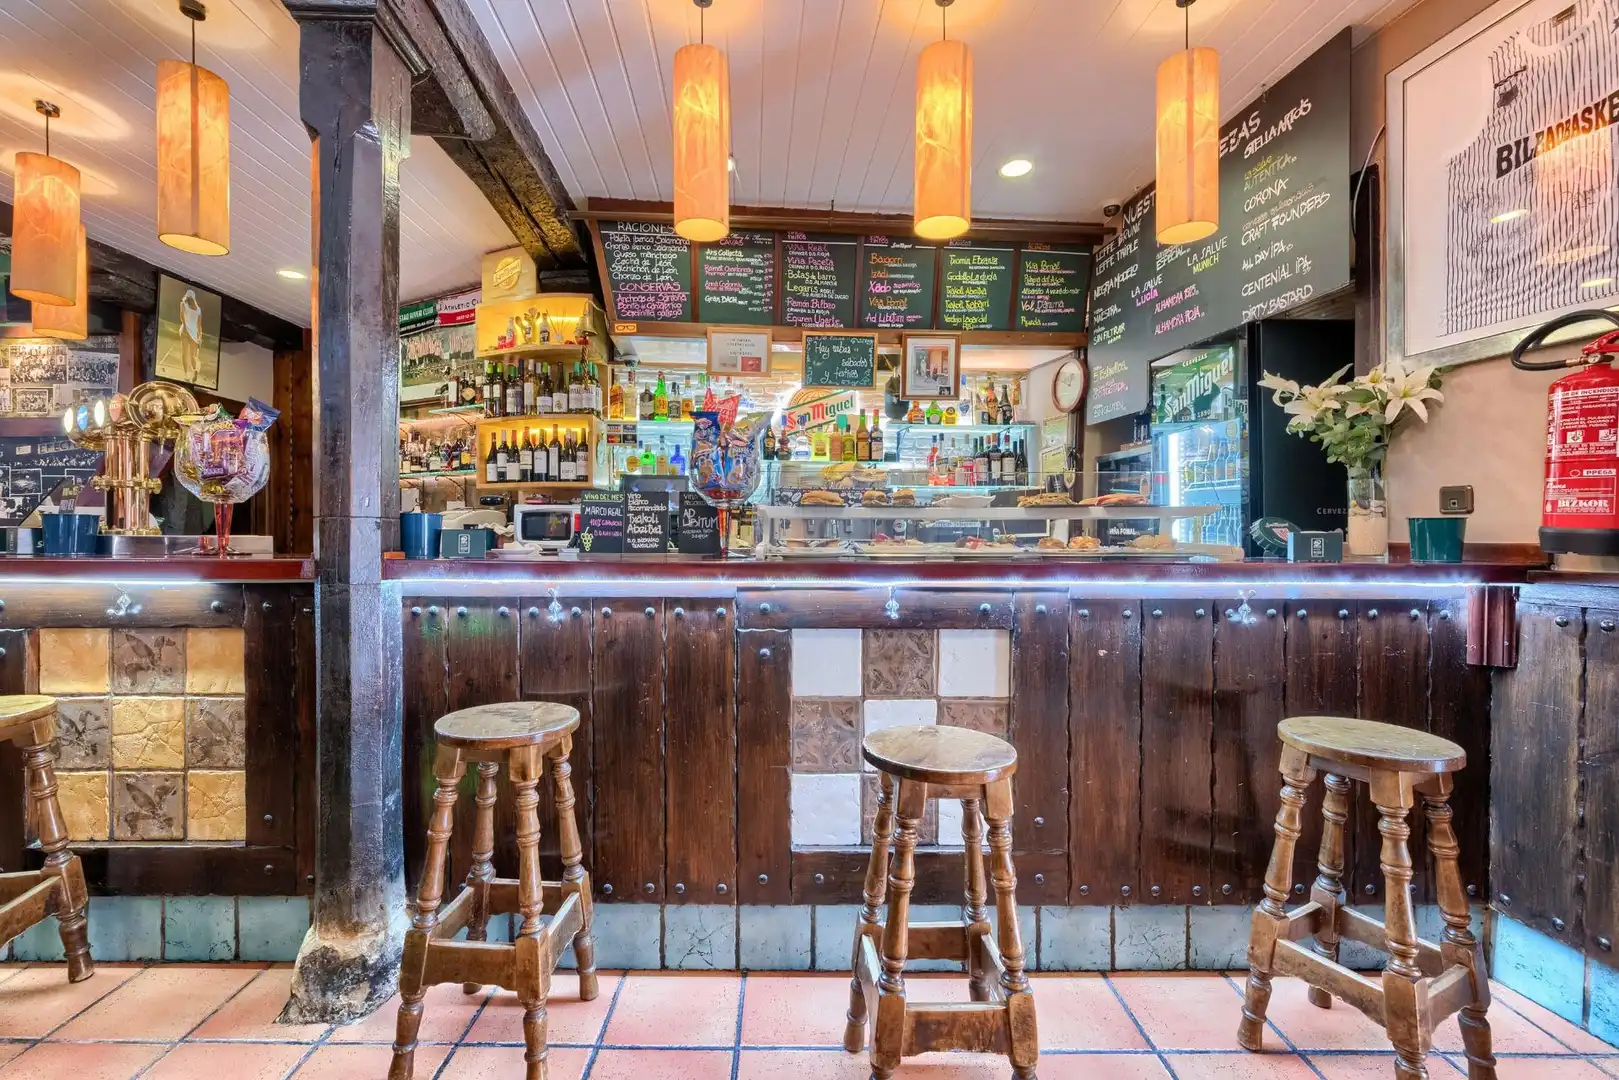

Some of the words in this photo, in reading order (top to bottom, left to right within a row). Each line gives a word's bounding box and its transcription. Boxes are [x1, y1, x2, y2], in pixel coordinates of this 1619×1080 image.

[1244, 178, 1289, 212] CORONA
[1241, 218, 1271, 247] CRAFT
[1271, 191, 1331, 231] FOUNDERS
[617, 221, 676, 235] RACIONES
[719, 238, 745, 246] CAVAS
[613, 249, 637, 259] Queso
[1187, 253, 1199, 267] LA
[1200, 235, 1228, 259] SALVE
[1254, 247, 1270, 266] DAY
[641, 259, 651, 267] de
[1192, 252, 1220, 275] MUNICH
[787, 269, 810, 280] Botas
[817, 271, 837, 281] barro
[619, 282, 681, 291] CONSERVAS
[1131, 286, 1141, 299] LA
[1141, 273, 1164, 294] SALVE
[721, 295, 737, 303] BACH
[1268, 283, 1314, 316] BASTARD
[410, 309, 423, 319] RIVER
[813, 340, 830, 360] Hay
[819, 370, 831, 384] y
[1163, 390, 1188, 424] San
[1186, 346, 1235, 408] Miguel
[786, 411, 811, 432] San
[810, 394, 854, 422] Miguel
[584, 493, 601, 501] VINO
[610, 494, 625, 503] MES
[628, 499, 649, 507] blanco
[1557, 499, 1609, 508] BIZKOR
[584, 506, 608, 516] MARCO
[607, 507, 624, 517] REAL
[682, 508, 696, 518] AD
